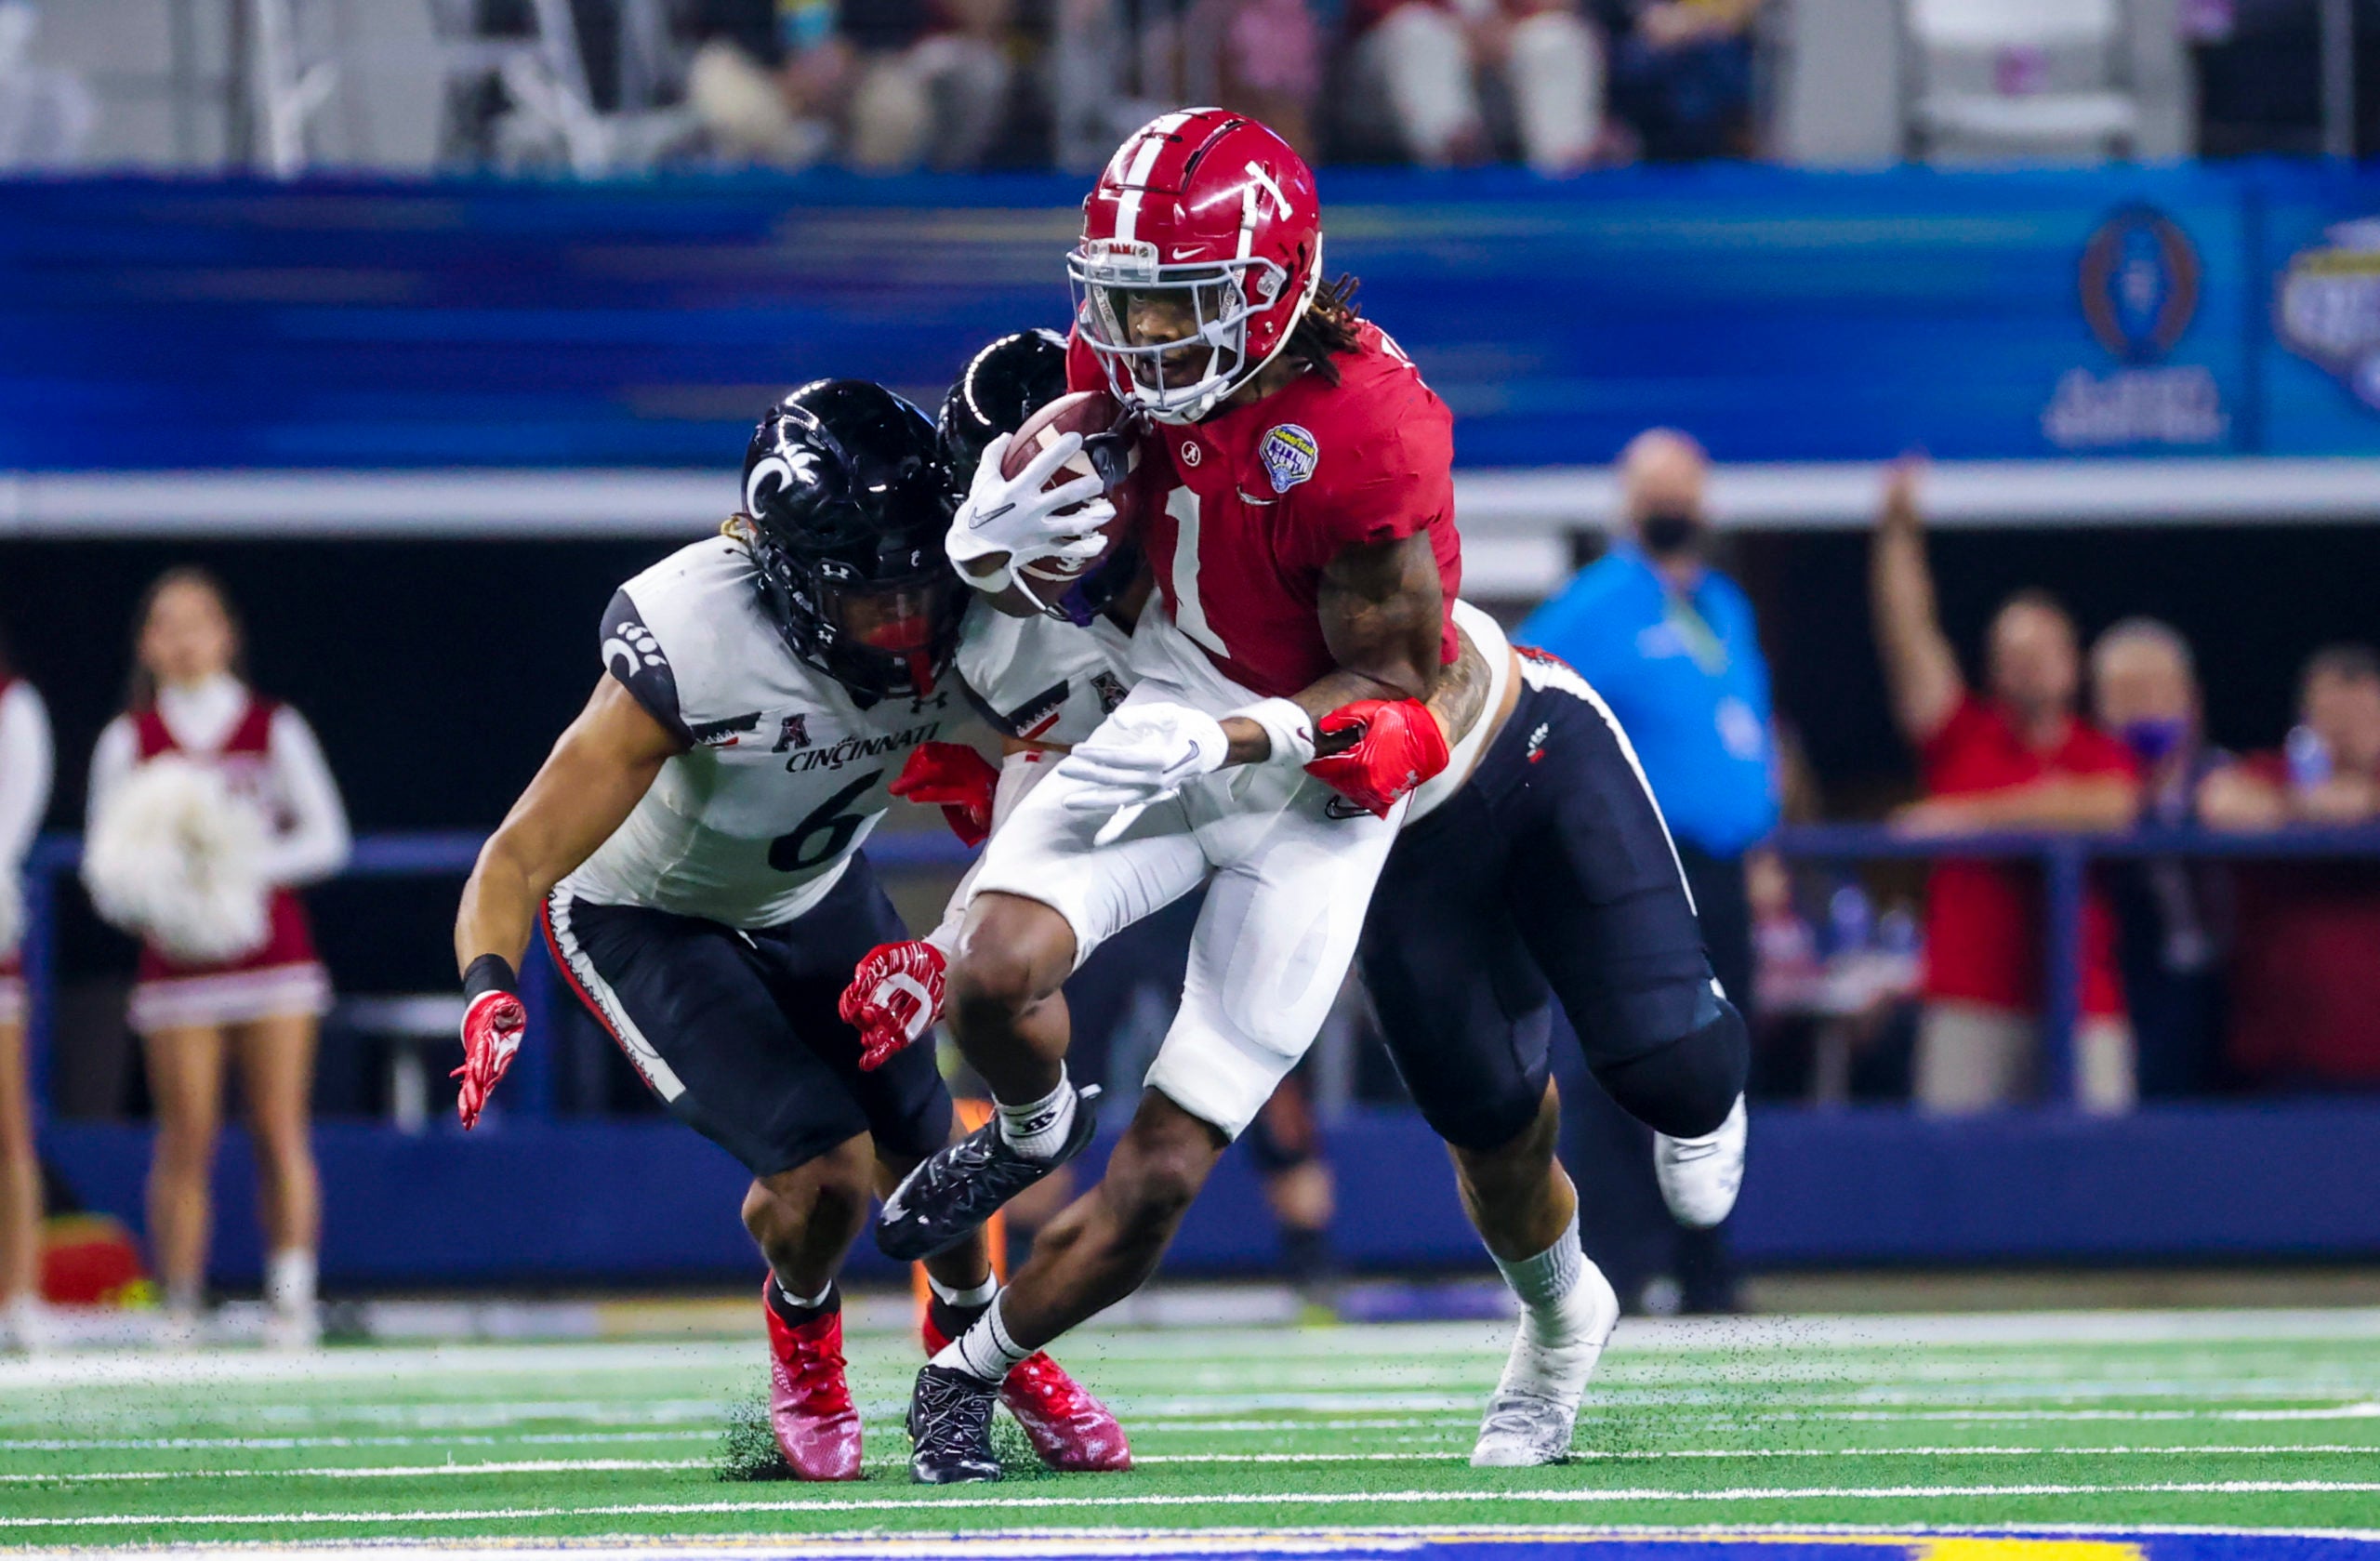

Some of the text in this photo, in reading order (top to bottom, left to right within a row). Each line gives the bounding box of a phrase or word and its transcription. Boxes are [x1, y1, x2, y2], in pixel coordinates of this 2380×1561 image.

[1265, 435, 1312, 472] COTTON
[1165, 484, 1231, 659] 1
[786, 721, 940, 773] CINCINNATI
[768, 770, 884, 872] 6
